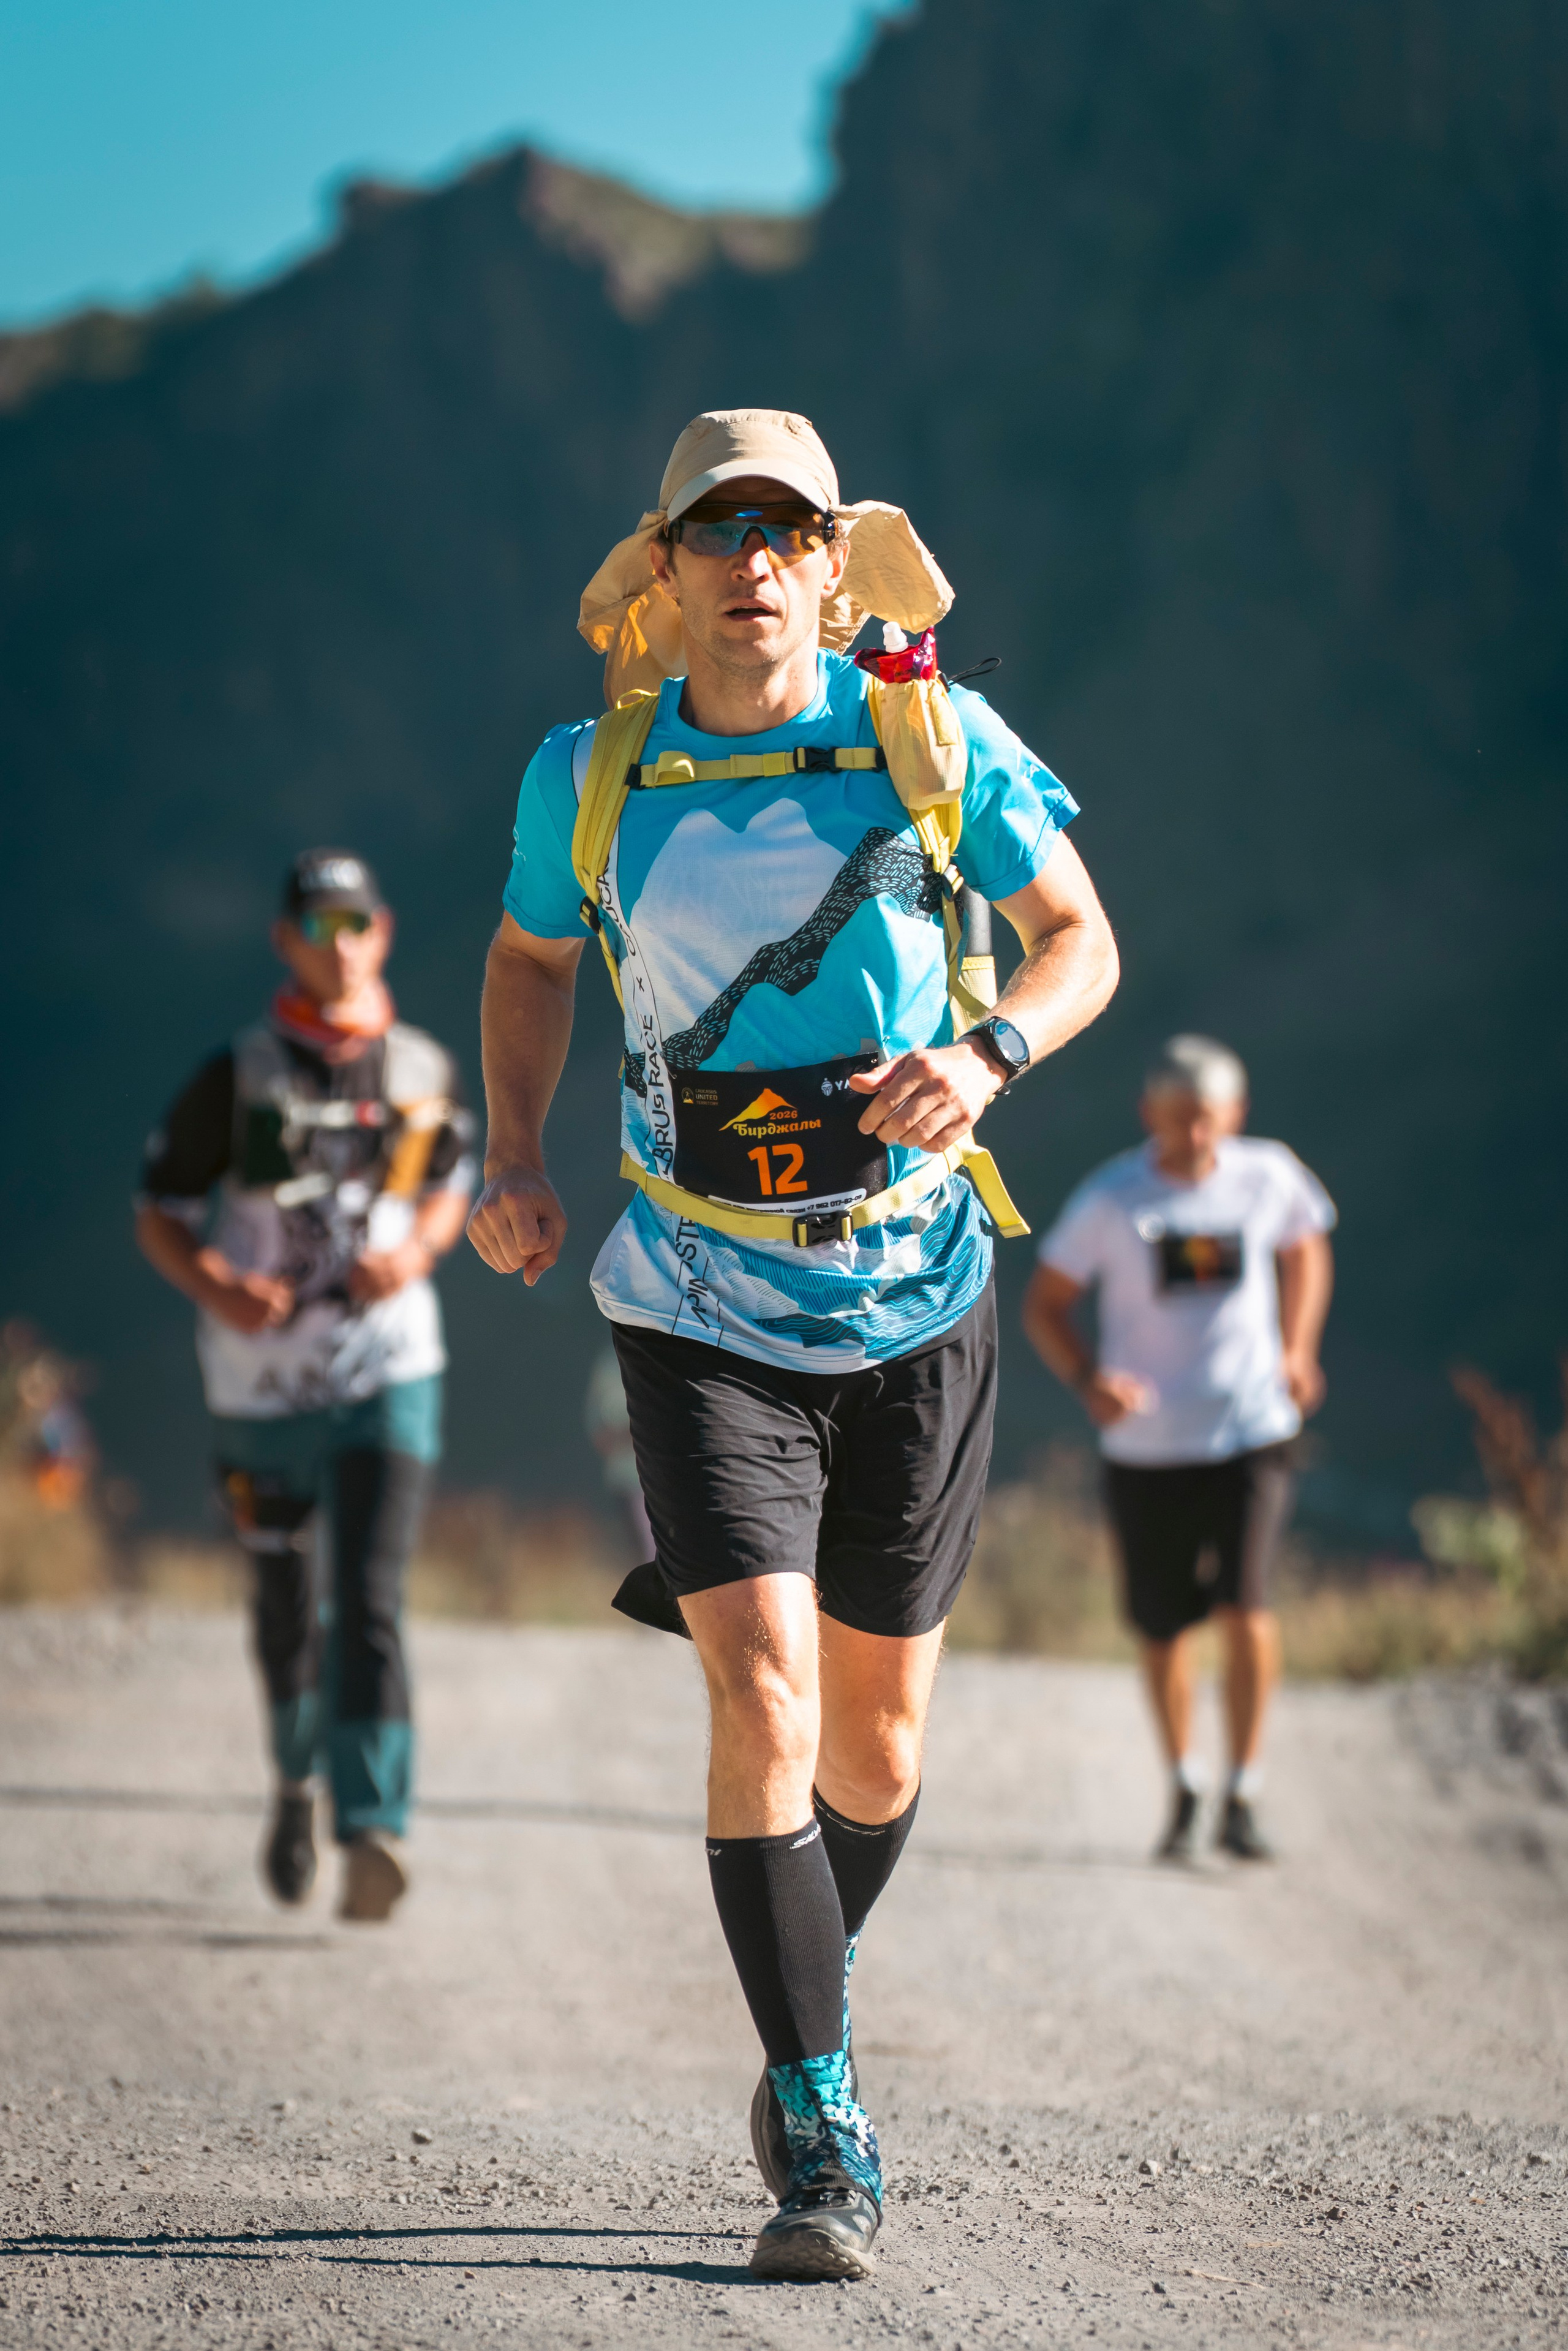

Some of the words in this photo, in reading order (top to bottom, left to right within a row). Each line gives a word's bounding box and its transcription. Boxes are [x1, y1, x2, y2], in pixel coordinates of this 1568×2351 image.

[640, 1014, 664, 1087] RACE
[733, 1119, 821, 1139] Бирджалы
[769, 1111, 798, 1120] 2026
[747, 1143, 808, 1196] 12
